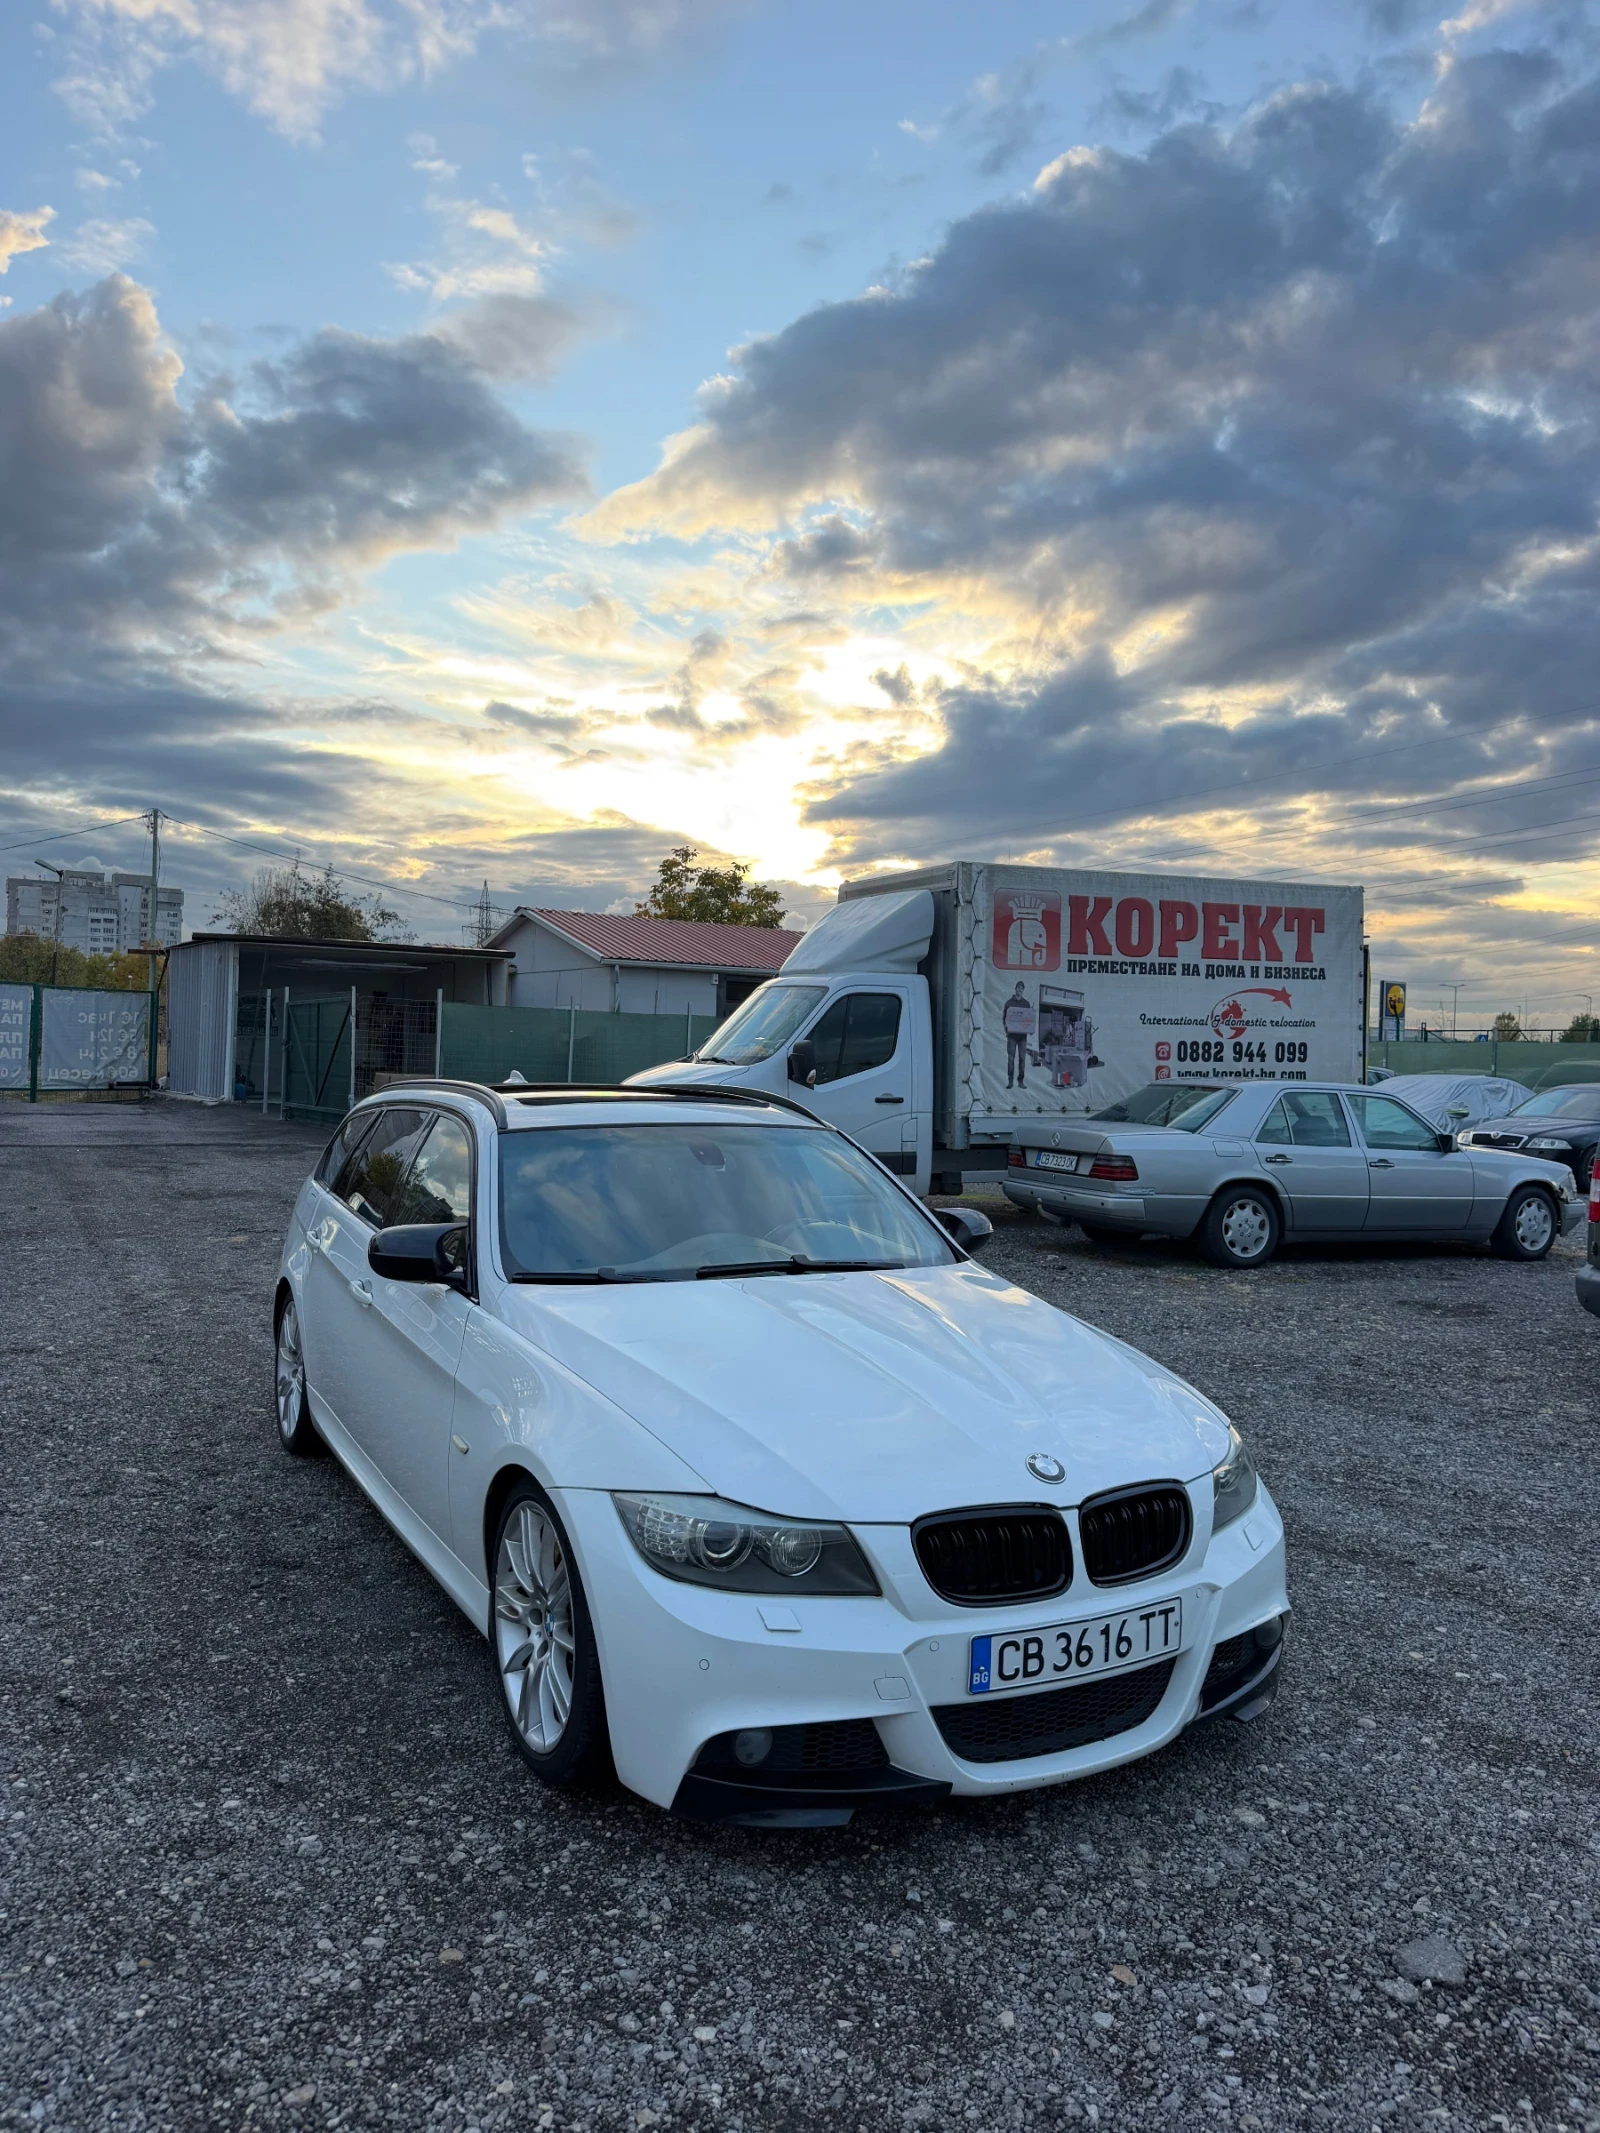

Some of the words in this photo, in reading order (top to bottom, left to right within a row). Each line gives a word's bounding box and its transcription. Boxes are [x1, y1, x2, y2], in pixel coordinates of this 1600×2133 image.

[1067, 895, 1325, 963] КОРЕКТ
[1067, 959, 1177, 976] ПРЕМЕСТВАНЕ
[1181, 963, 1201, 977] НА
[1205, 964, 1246, 980] ДОМА
[1250, 965, 1260, 979] И
[1264, 966, 1327, 980] БИЗНЕСА
[1139, 1013, 1209, 1027] International
[1211, 1015, 1222, 1028] &
[1224, 1015, 1267, 1028] domestic
[1269, 1016, 1316, 1028] relocation
[1177, 1041, 1225, 1063] 0882
[1232, 1041, 1267, 1063] 944
[1275, 1041, 1308, 1063] 099
[972, 1672, 989, 1685] BG
[998, 1636, 1045, 1682] CB
[1053, 1618, 1133, 1673] 3616
[1139, 1606, 1175, 1652] TT
